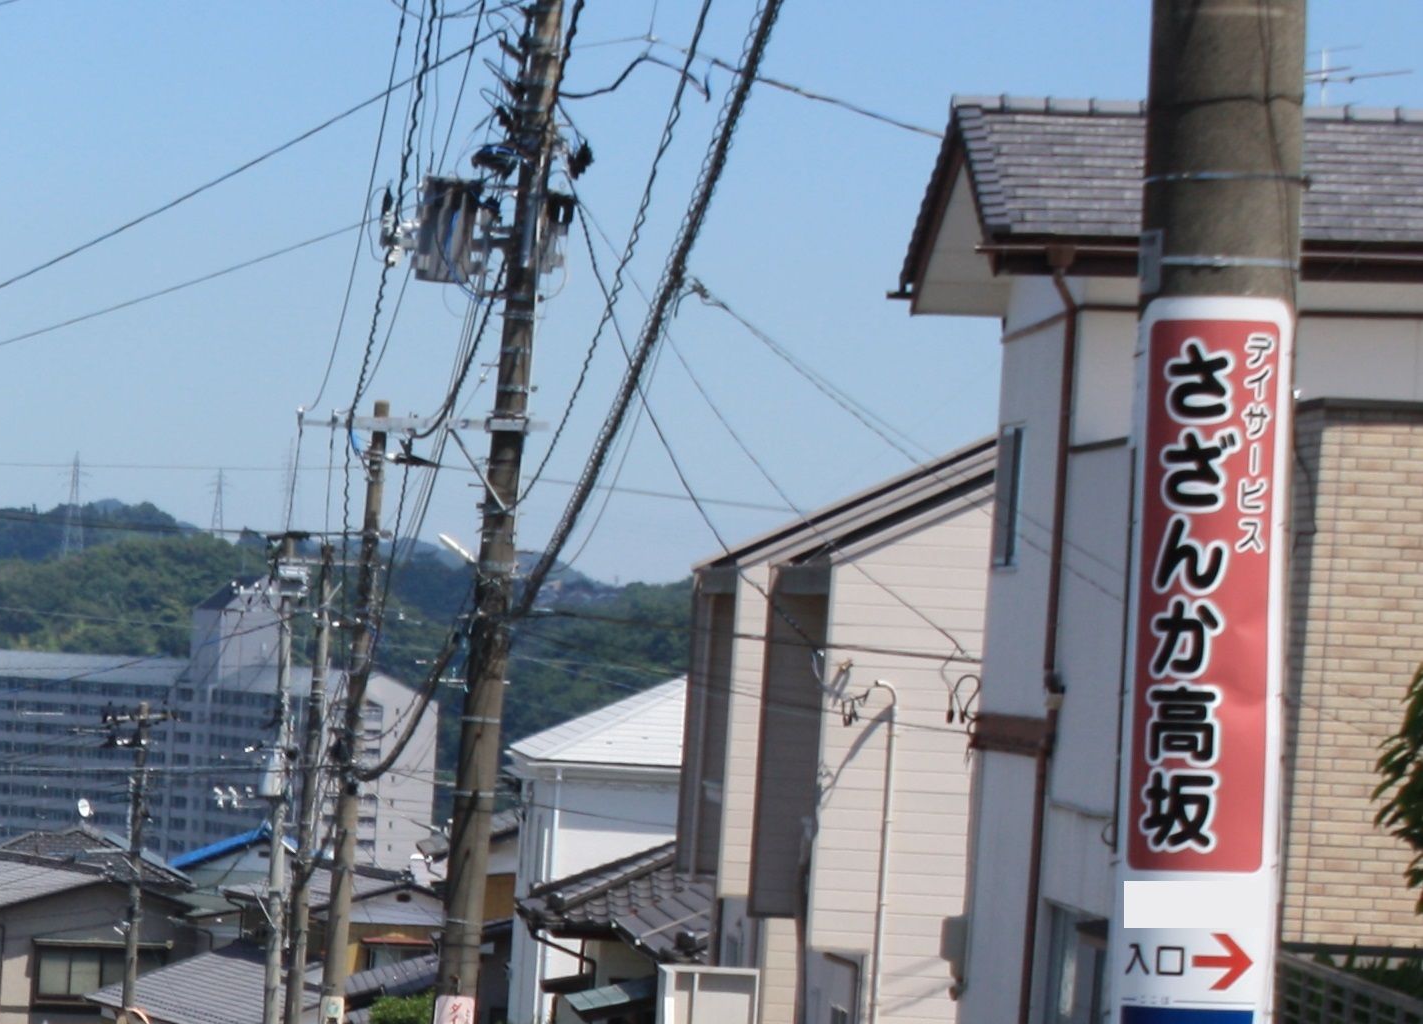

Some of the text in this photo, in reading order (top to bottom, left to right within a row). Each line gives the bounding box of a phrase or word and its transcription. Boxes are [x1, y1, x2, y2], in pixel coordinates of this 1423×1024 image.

[1143, 343, 1235, 847] さざんか高坂
[1125, 943, 1184, 976] 入口
